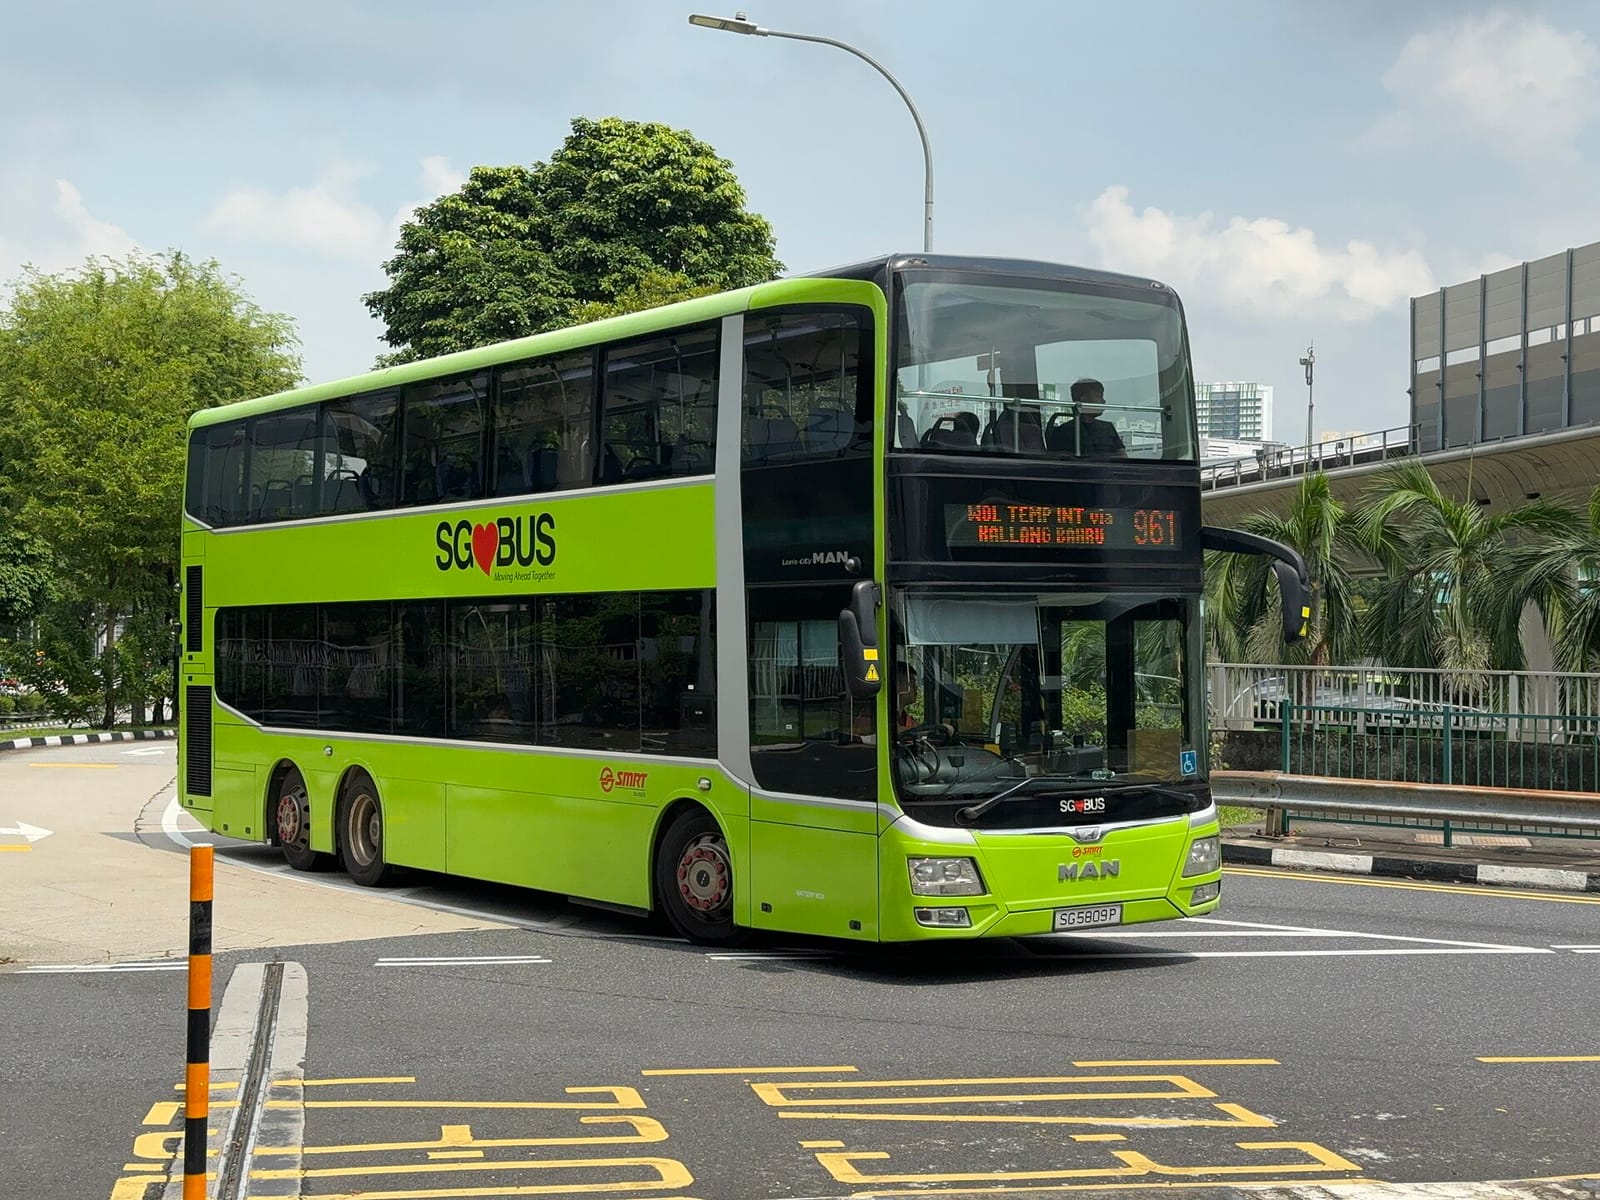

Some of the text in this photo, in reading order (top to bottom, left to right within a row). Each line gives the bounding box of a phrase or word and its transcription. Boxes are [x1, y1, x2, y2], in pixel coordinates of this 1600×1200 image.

[1008, 506, 1051, 522] TEMP
[1057, 508, 1084, 524] INT
[1089, 509, 1113, 524] via
[979, 525, 1104, 544] KALLANG BAHRU
[1134, 509, 1174, 545] 961
[812, 551, 849, 564] MAN
[494, 570, 556, 583] Moving Ahead Together
[615, 771, 648, 788] SMRT
[1082, 846, 1103, 855] SMRT
[1058, 859, 1120, 883] MAN
[1060, 908, 1117, 925] SG5809P
